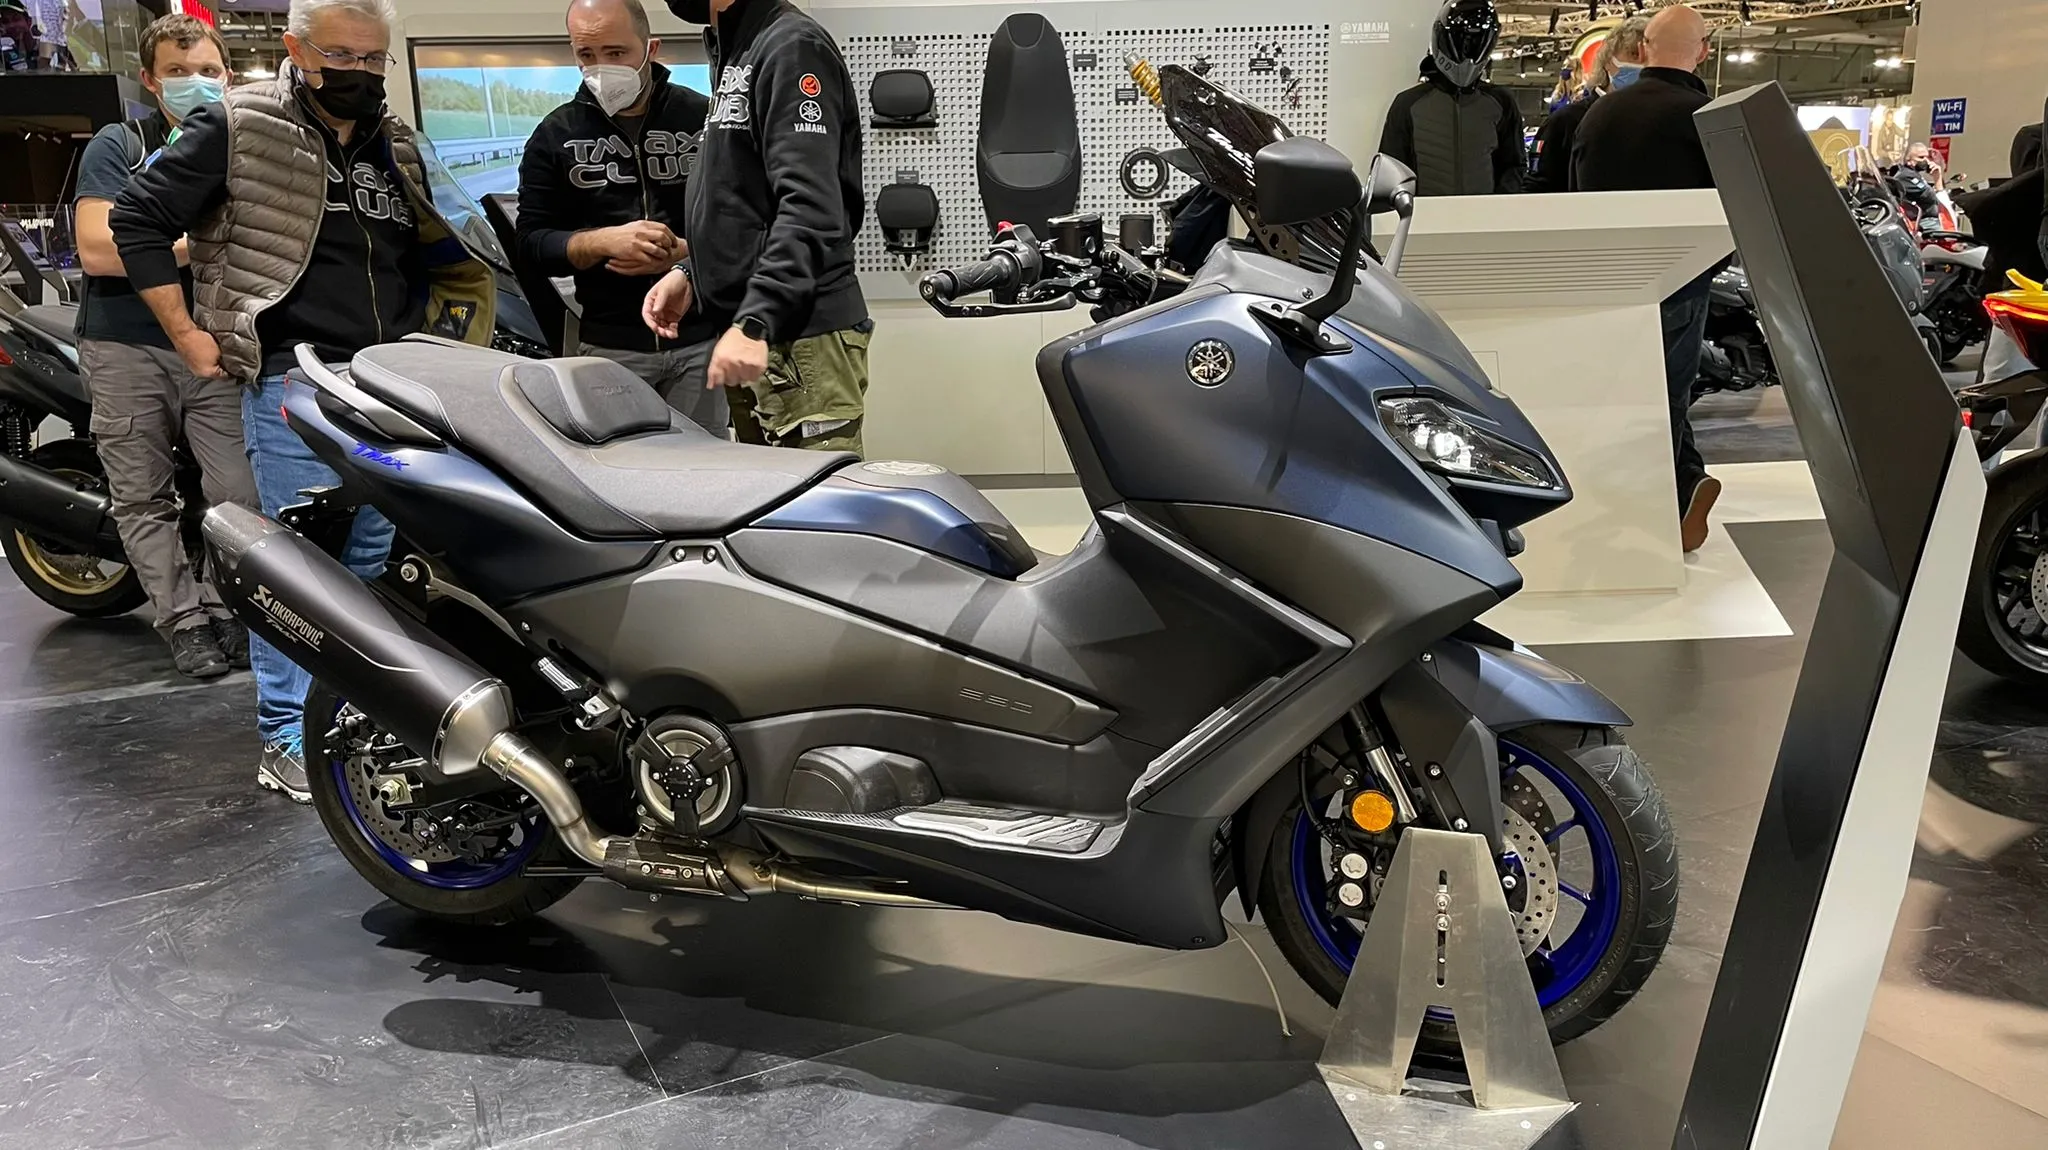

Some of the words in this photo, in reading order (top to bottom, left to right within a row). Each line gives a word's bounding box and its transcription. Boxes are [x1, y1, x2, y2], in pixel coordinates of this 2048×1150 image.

[1351, 21, 1390, 33] YAMAHA
[1937, 101, 1963, 113] Wi-Fi
[793, 122, 828, 135] YAMAHA
[1944, 122, 1961, 132] TIM
